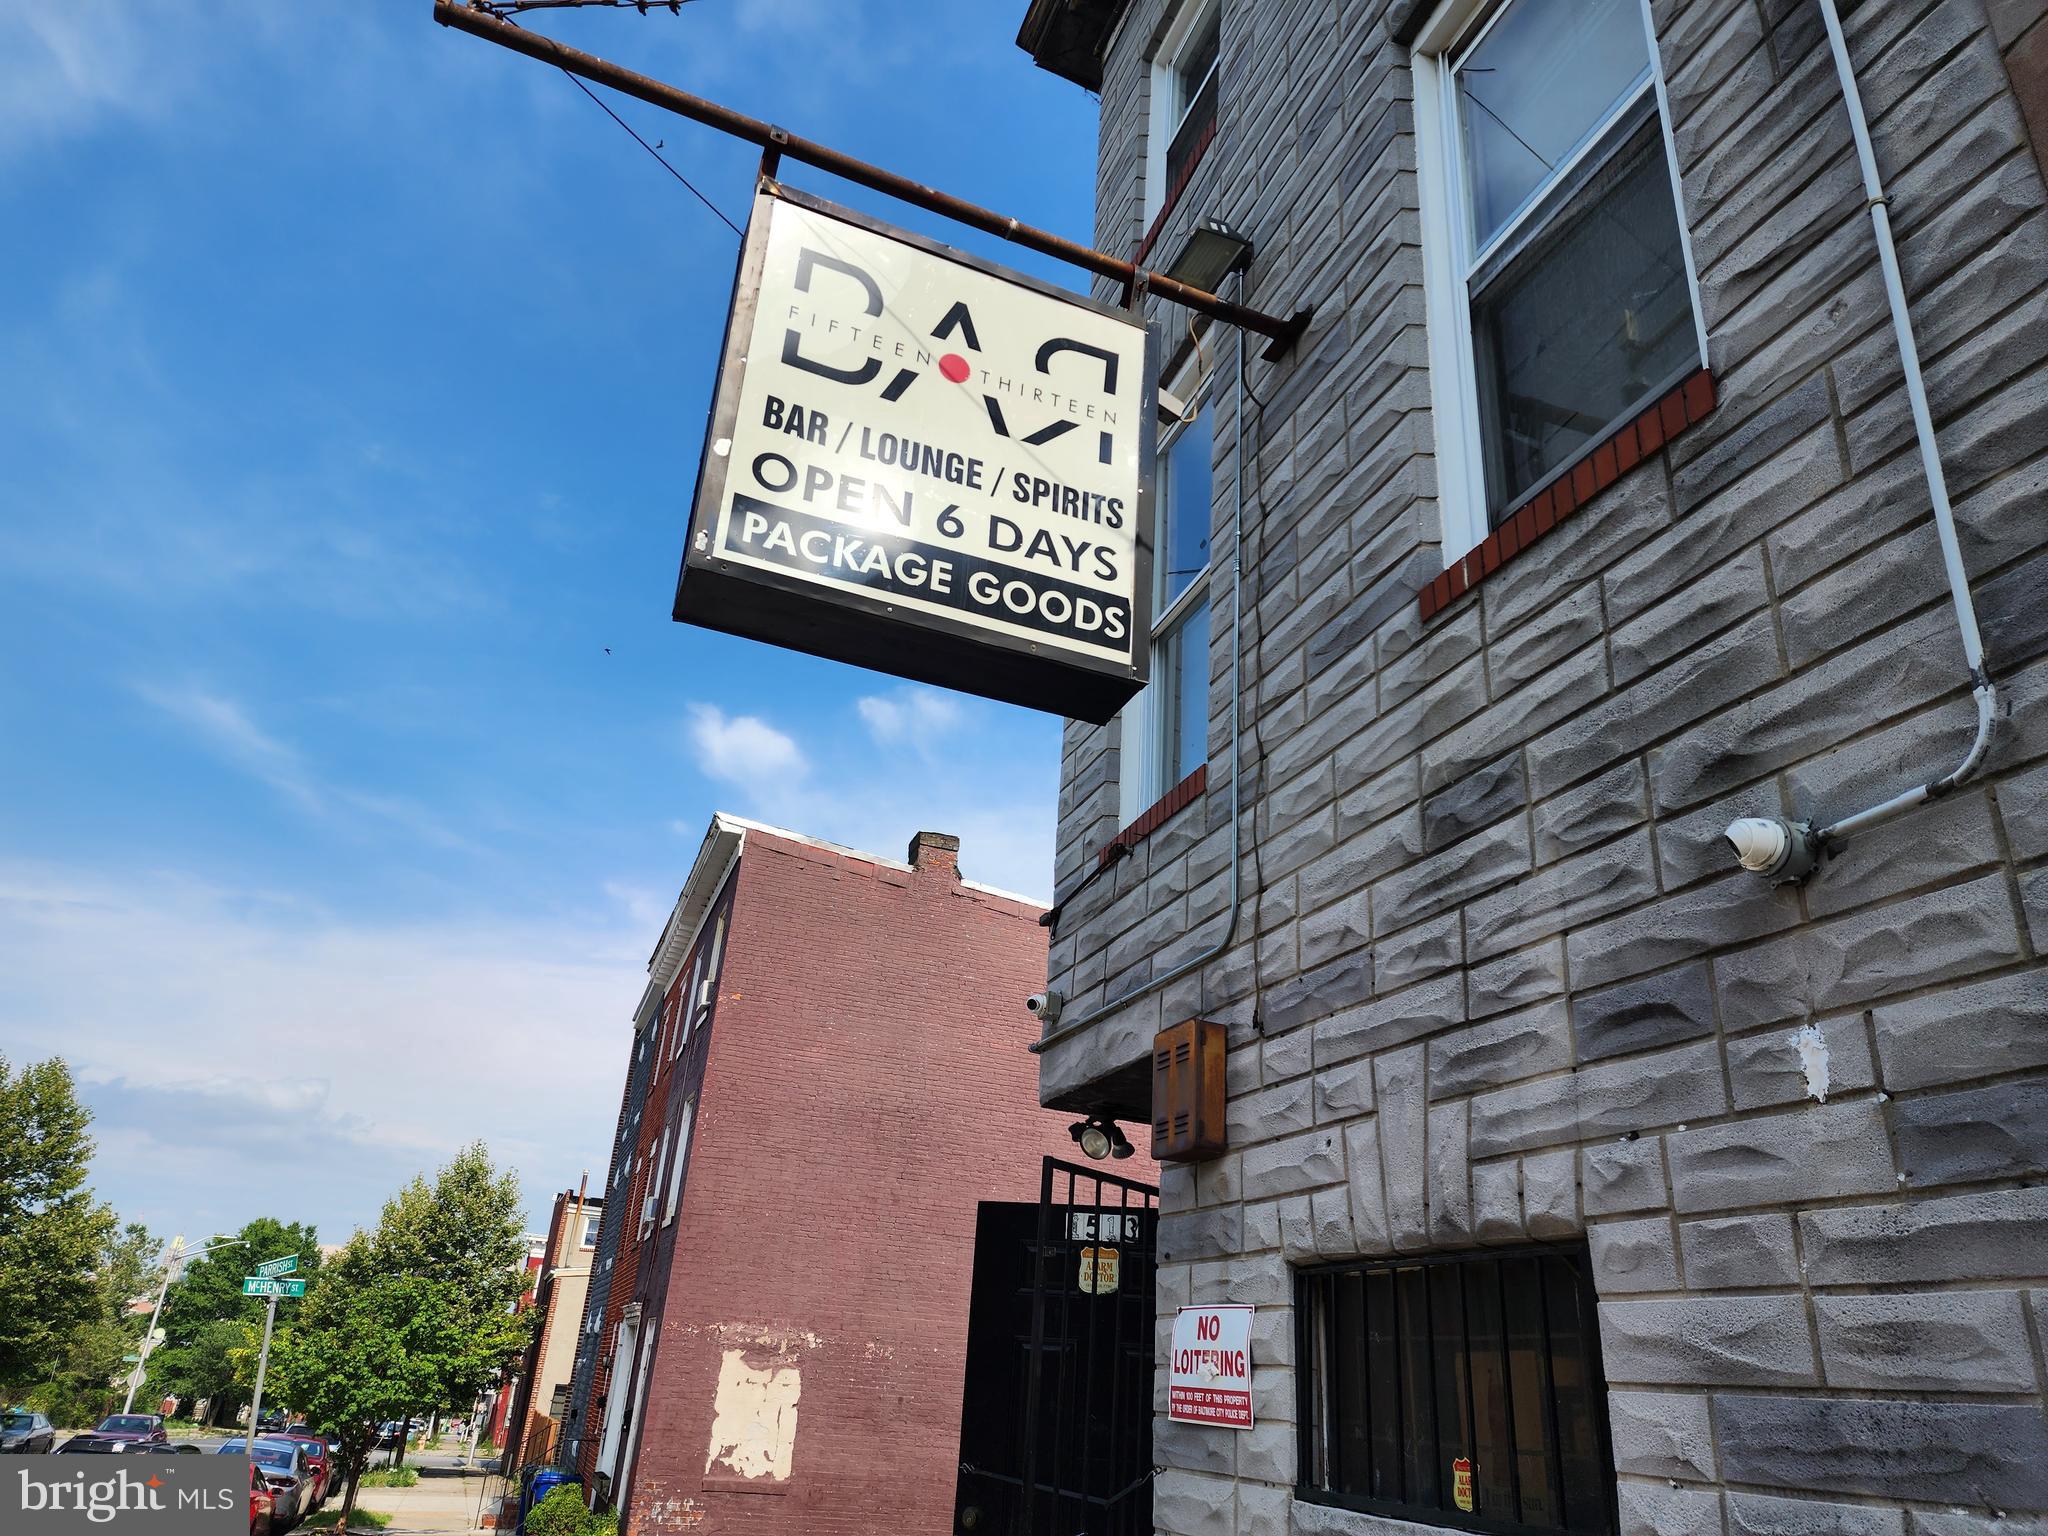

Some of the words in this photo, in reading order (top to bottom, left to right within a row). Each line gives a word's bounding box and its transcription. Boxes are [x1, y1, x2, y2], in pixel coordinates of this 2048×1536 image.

[788, 305, 930, 366] FIFTEEN
[980, 370, 1117, 424] THIRTEEN
[762, 394, 829, 446] BAR
[860, 426, 984, 490] LOUNGE
[1012, 471, 1124, 529] SPIRITS
[751, 451, 914, 528] OPEN
[936, 503, 965, 539] 6
[988, 515, 1120, 582] DAYS
[741, 511, 954, 594] PACKAGE
[967, 571, 1126, 640] GOODS
[260, 1260, 287, 1277] PARRISH
[288, 1260, 293, 1268] ST
[1086, 1261, 1113, 1272] AARM
[1084, 1272, 1114, 1283] DOTOR
[291, 1284, 298, 1292] ST
[1197, 1315, 1220, 1341] NO
[1171, 1391, 1185, 1400] WITHIN
[1194, 1392, 1204, 1401] FEET
[1205, 1393, 1212, 1402] OF
[1213, 1394, 1223, 1404] THIS
[1224, 1395, 1248, 1406] PROPERTY
[1182, 1404, 1192, 1413] ORDER
[1198, 1406, 1216, 1416] BALTIMORE
[1216, 1408, 1225, 1417] CITY
[1225, 1409, 1238, 1419] POLICE
[1457, 1487, 1472, 1498] DOCT
